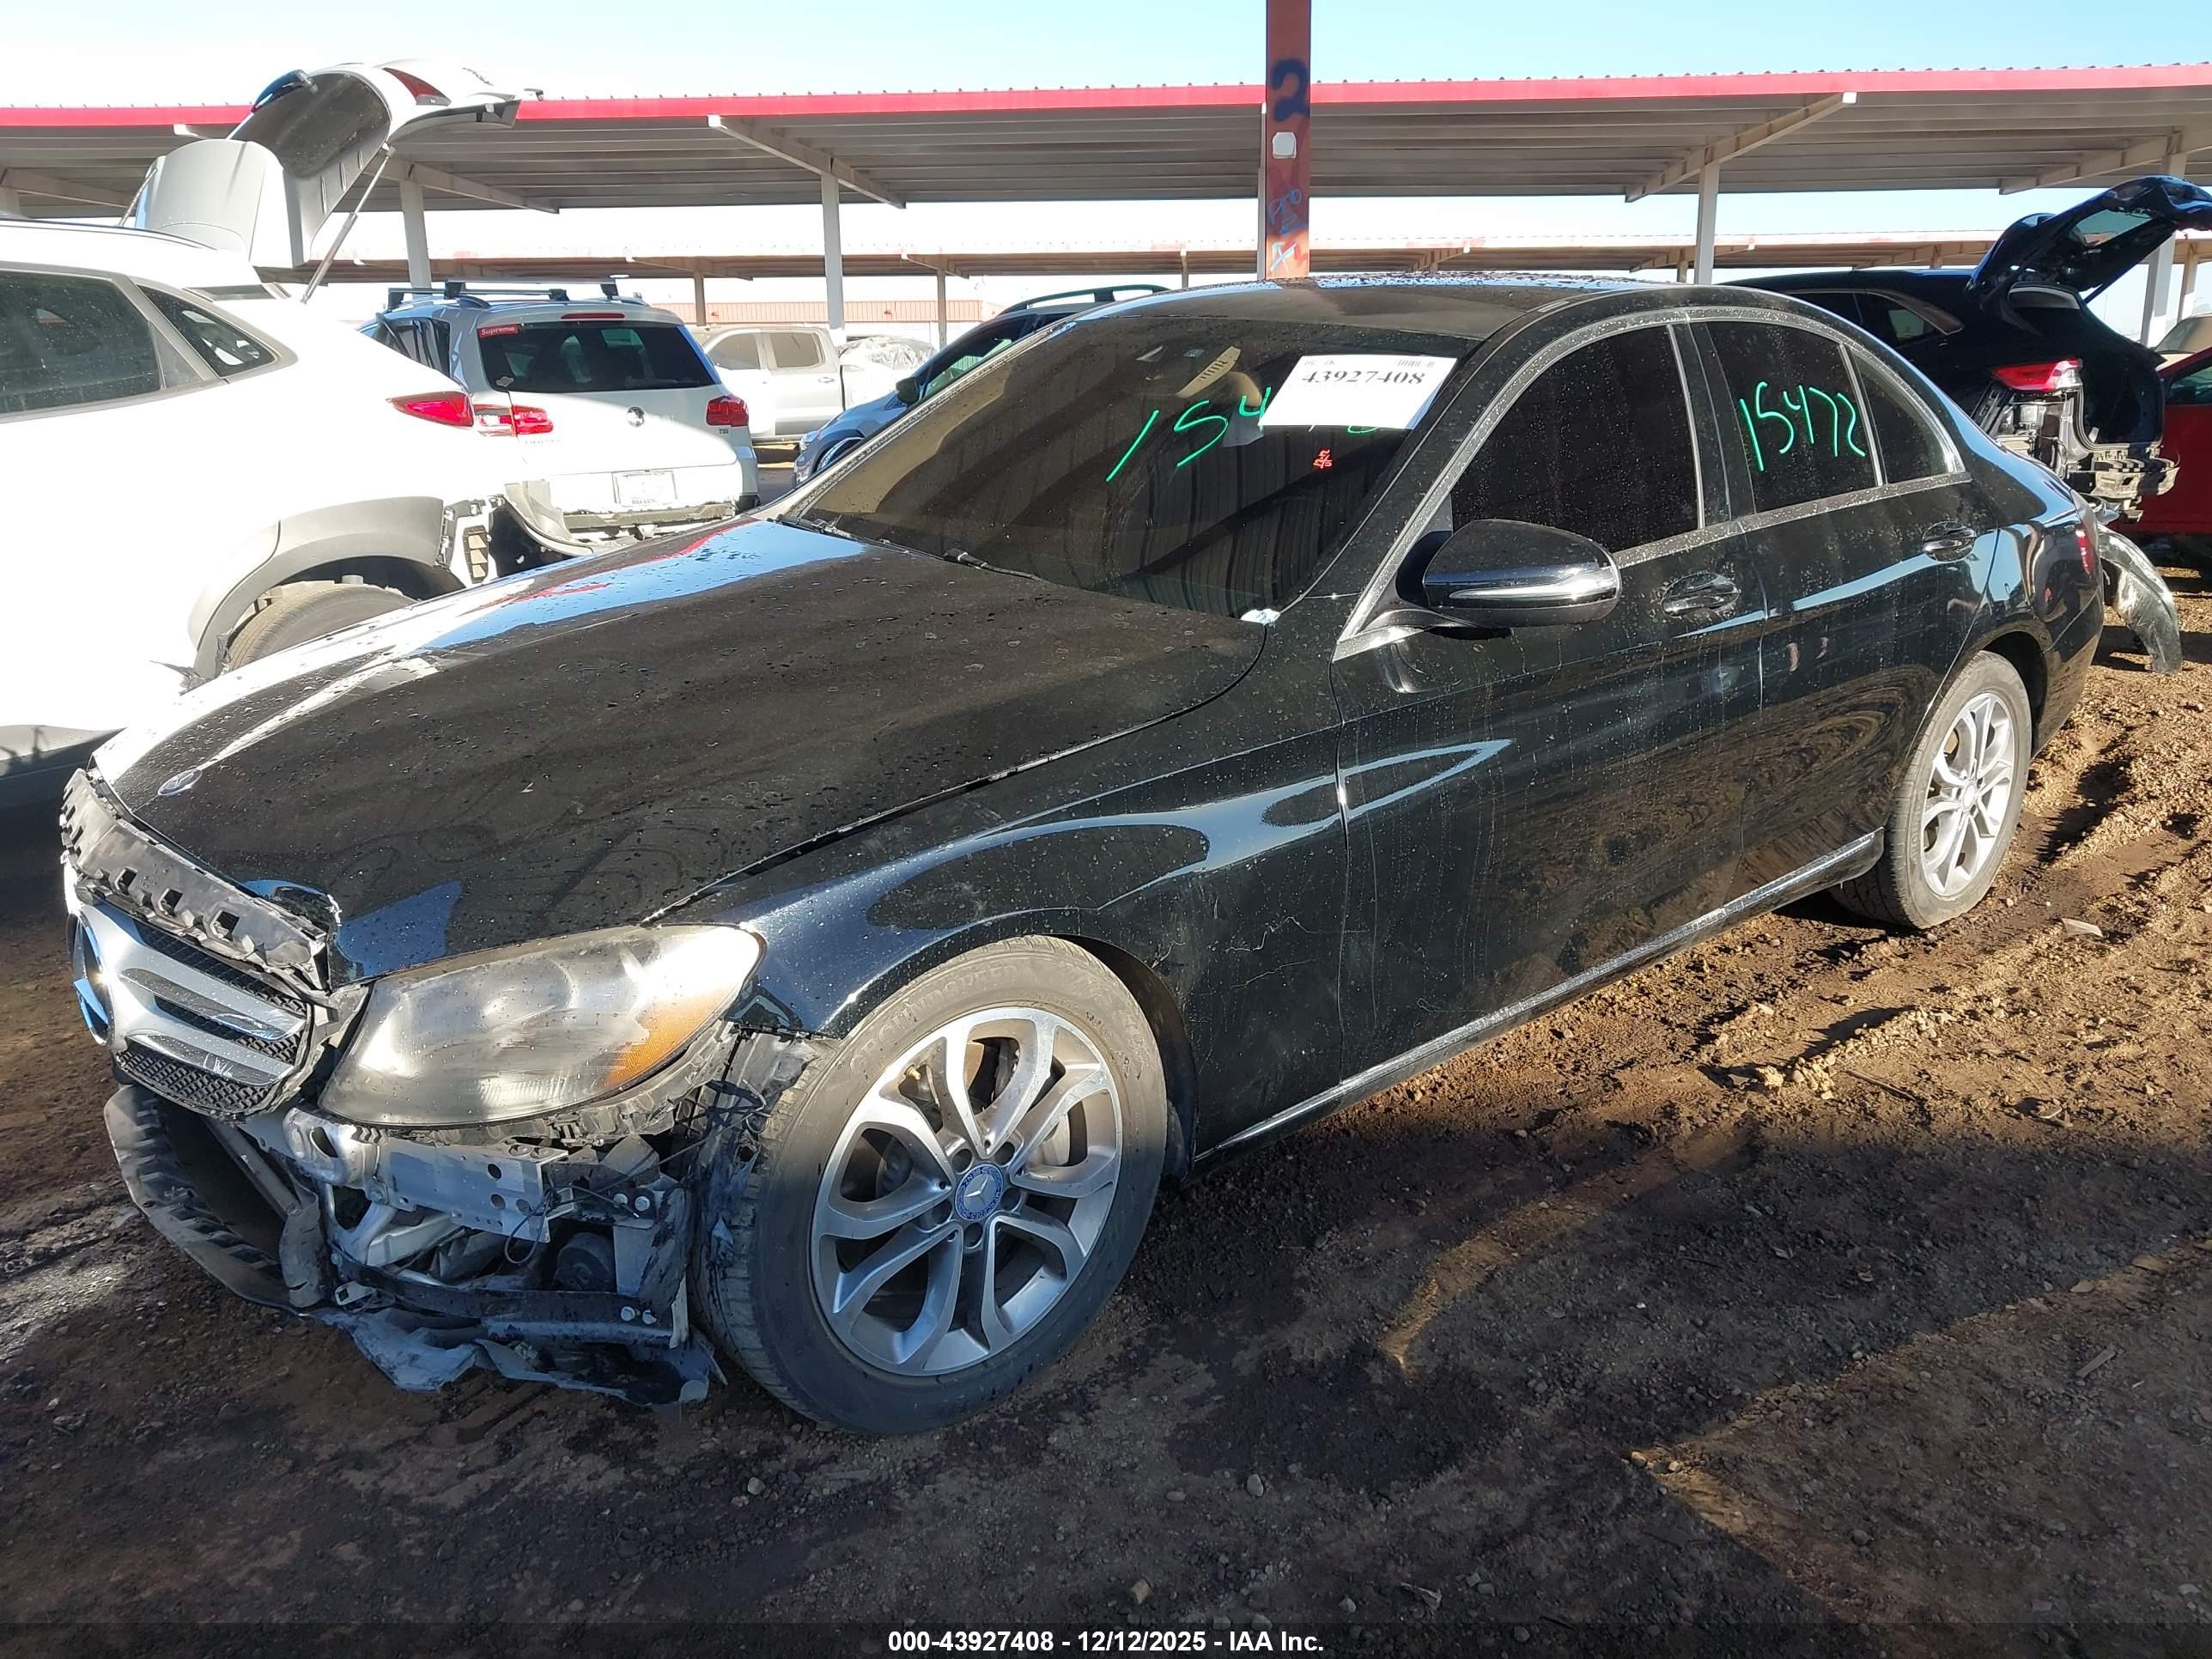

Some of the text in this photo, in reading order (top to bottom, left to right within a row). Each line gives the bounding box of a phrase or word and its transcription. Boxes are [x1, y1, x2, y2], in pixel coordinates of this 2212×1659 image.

[480, 326, 515, 336] Supreme
[1302, 370, 1426, 385] 43927408
[1740, 381, 1866, 471] 15472
